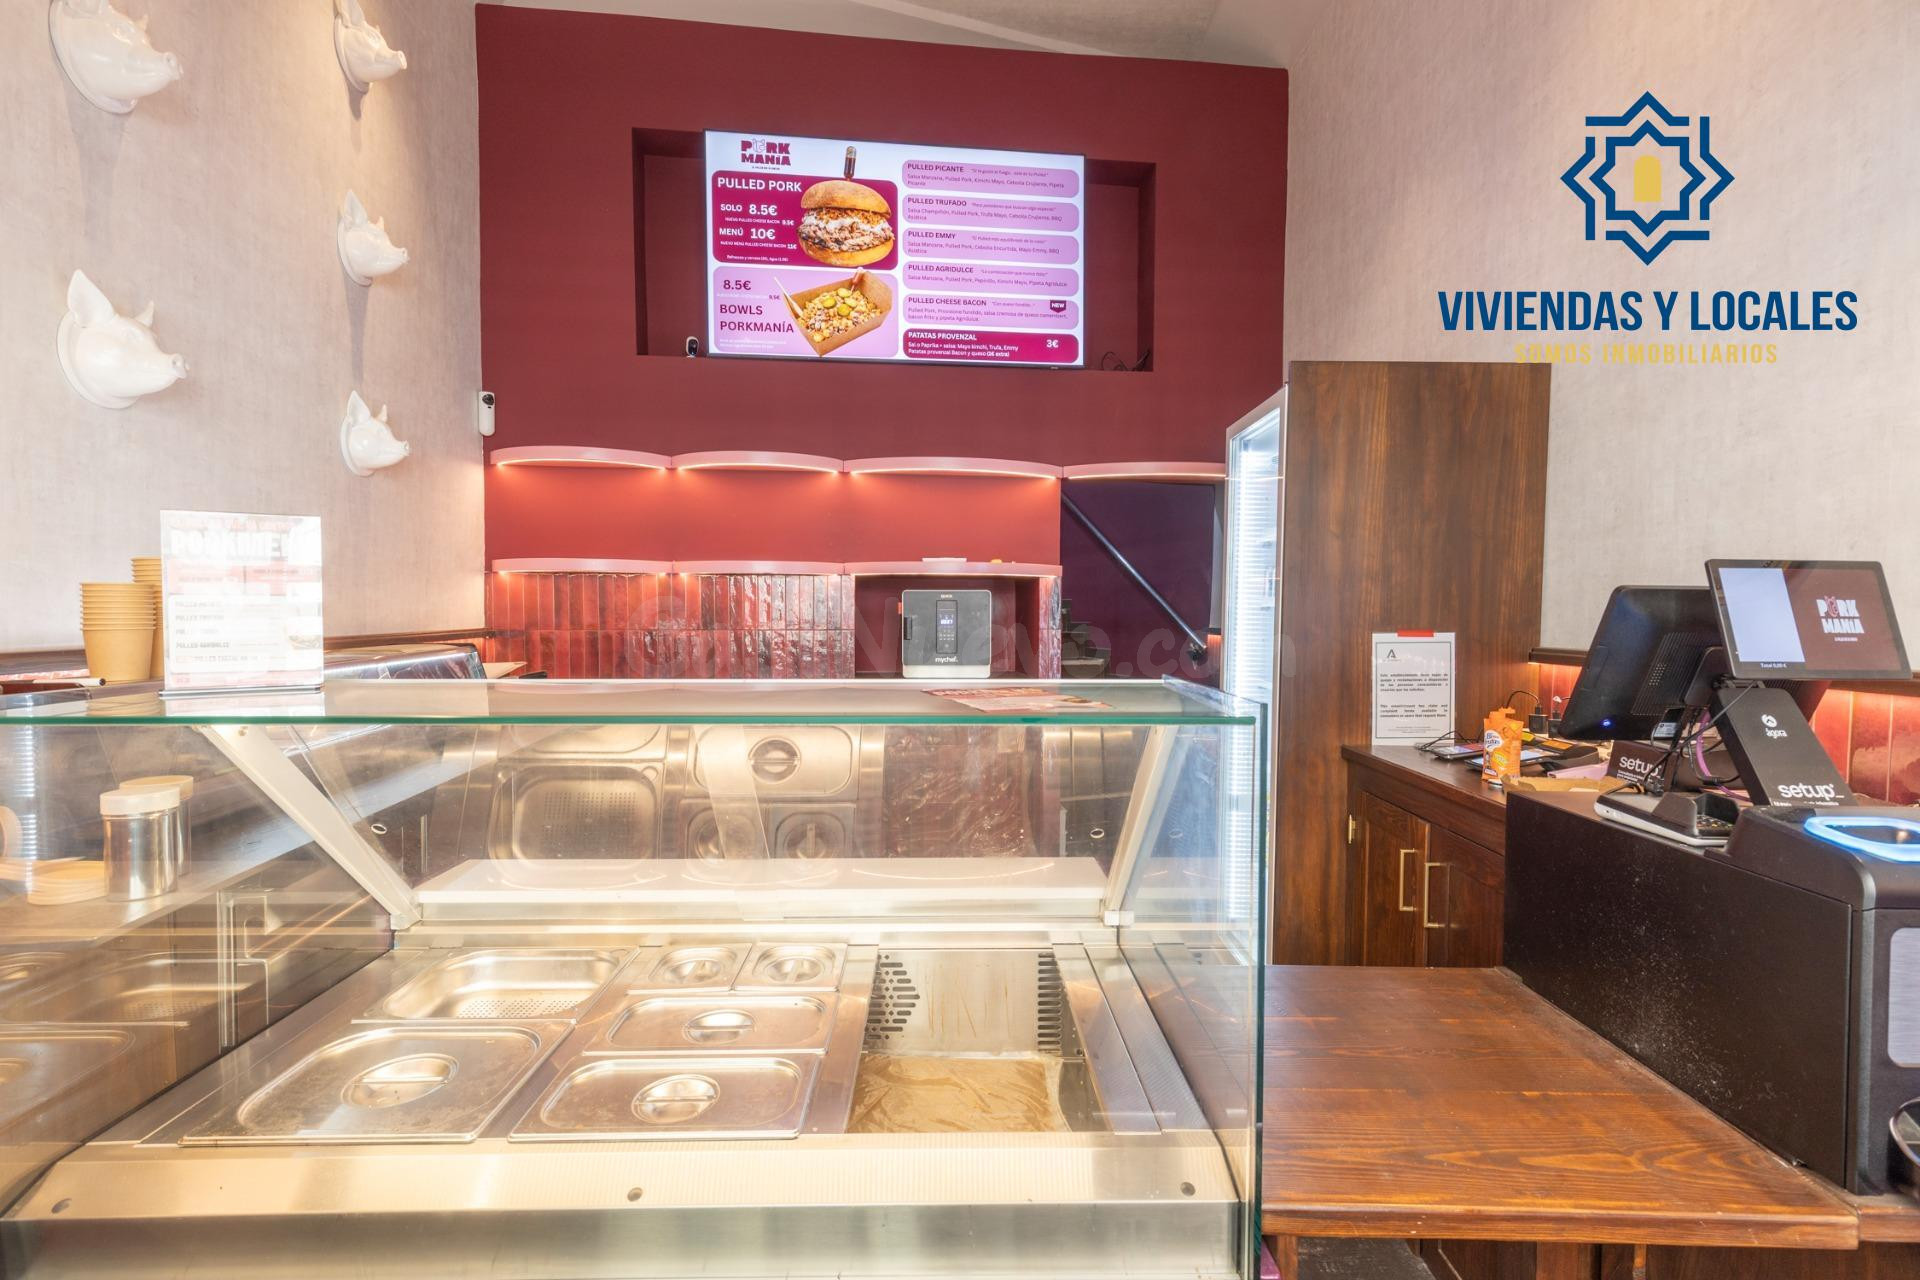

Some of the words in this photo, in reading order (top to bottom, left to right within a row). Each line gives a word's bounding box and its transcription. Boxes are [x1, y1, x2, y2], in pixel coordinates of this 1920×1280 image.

[908, 163, 934, 171] PULLED
[935, 165, 964, 173] PICANTE
[718, 177, 765, 190] PULLED
[768, 180, 803, 192] PORK
[908, 197, 934, 205] PULLED
[935, 199, 967, 207] TRUFADO
[720, 203, 742, 212] SOLO
[749, 203, 778, 216] 8.5€
[719, 227, 744, 236] MENÚ
[750, 228, 776, 240] 10€
[908, 231, 934, 239] PULLED
[935, 232, 956, 240] EMMY
[908, 264, 934, 272] PULLED
[935, 265, 974, 274] AGRIDULCE
[723, 279, 751, 291] 8.5€
[908, 297, 934, 305] PULLED
[935, 298, 961, 306] CHEESE
[962, 299, 987, 307] BACON
[719, 304, 763, 315] BOWLS
[720, 320, 794, 333] PORKMANÍA
[908, 331, 937, 340] PATATAS
[937, 332, 977, 341] PROVENZAL
[1046, 339, 1059, 349] 3€
